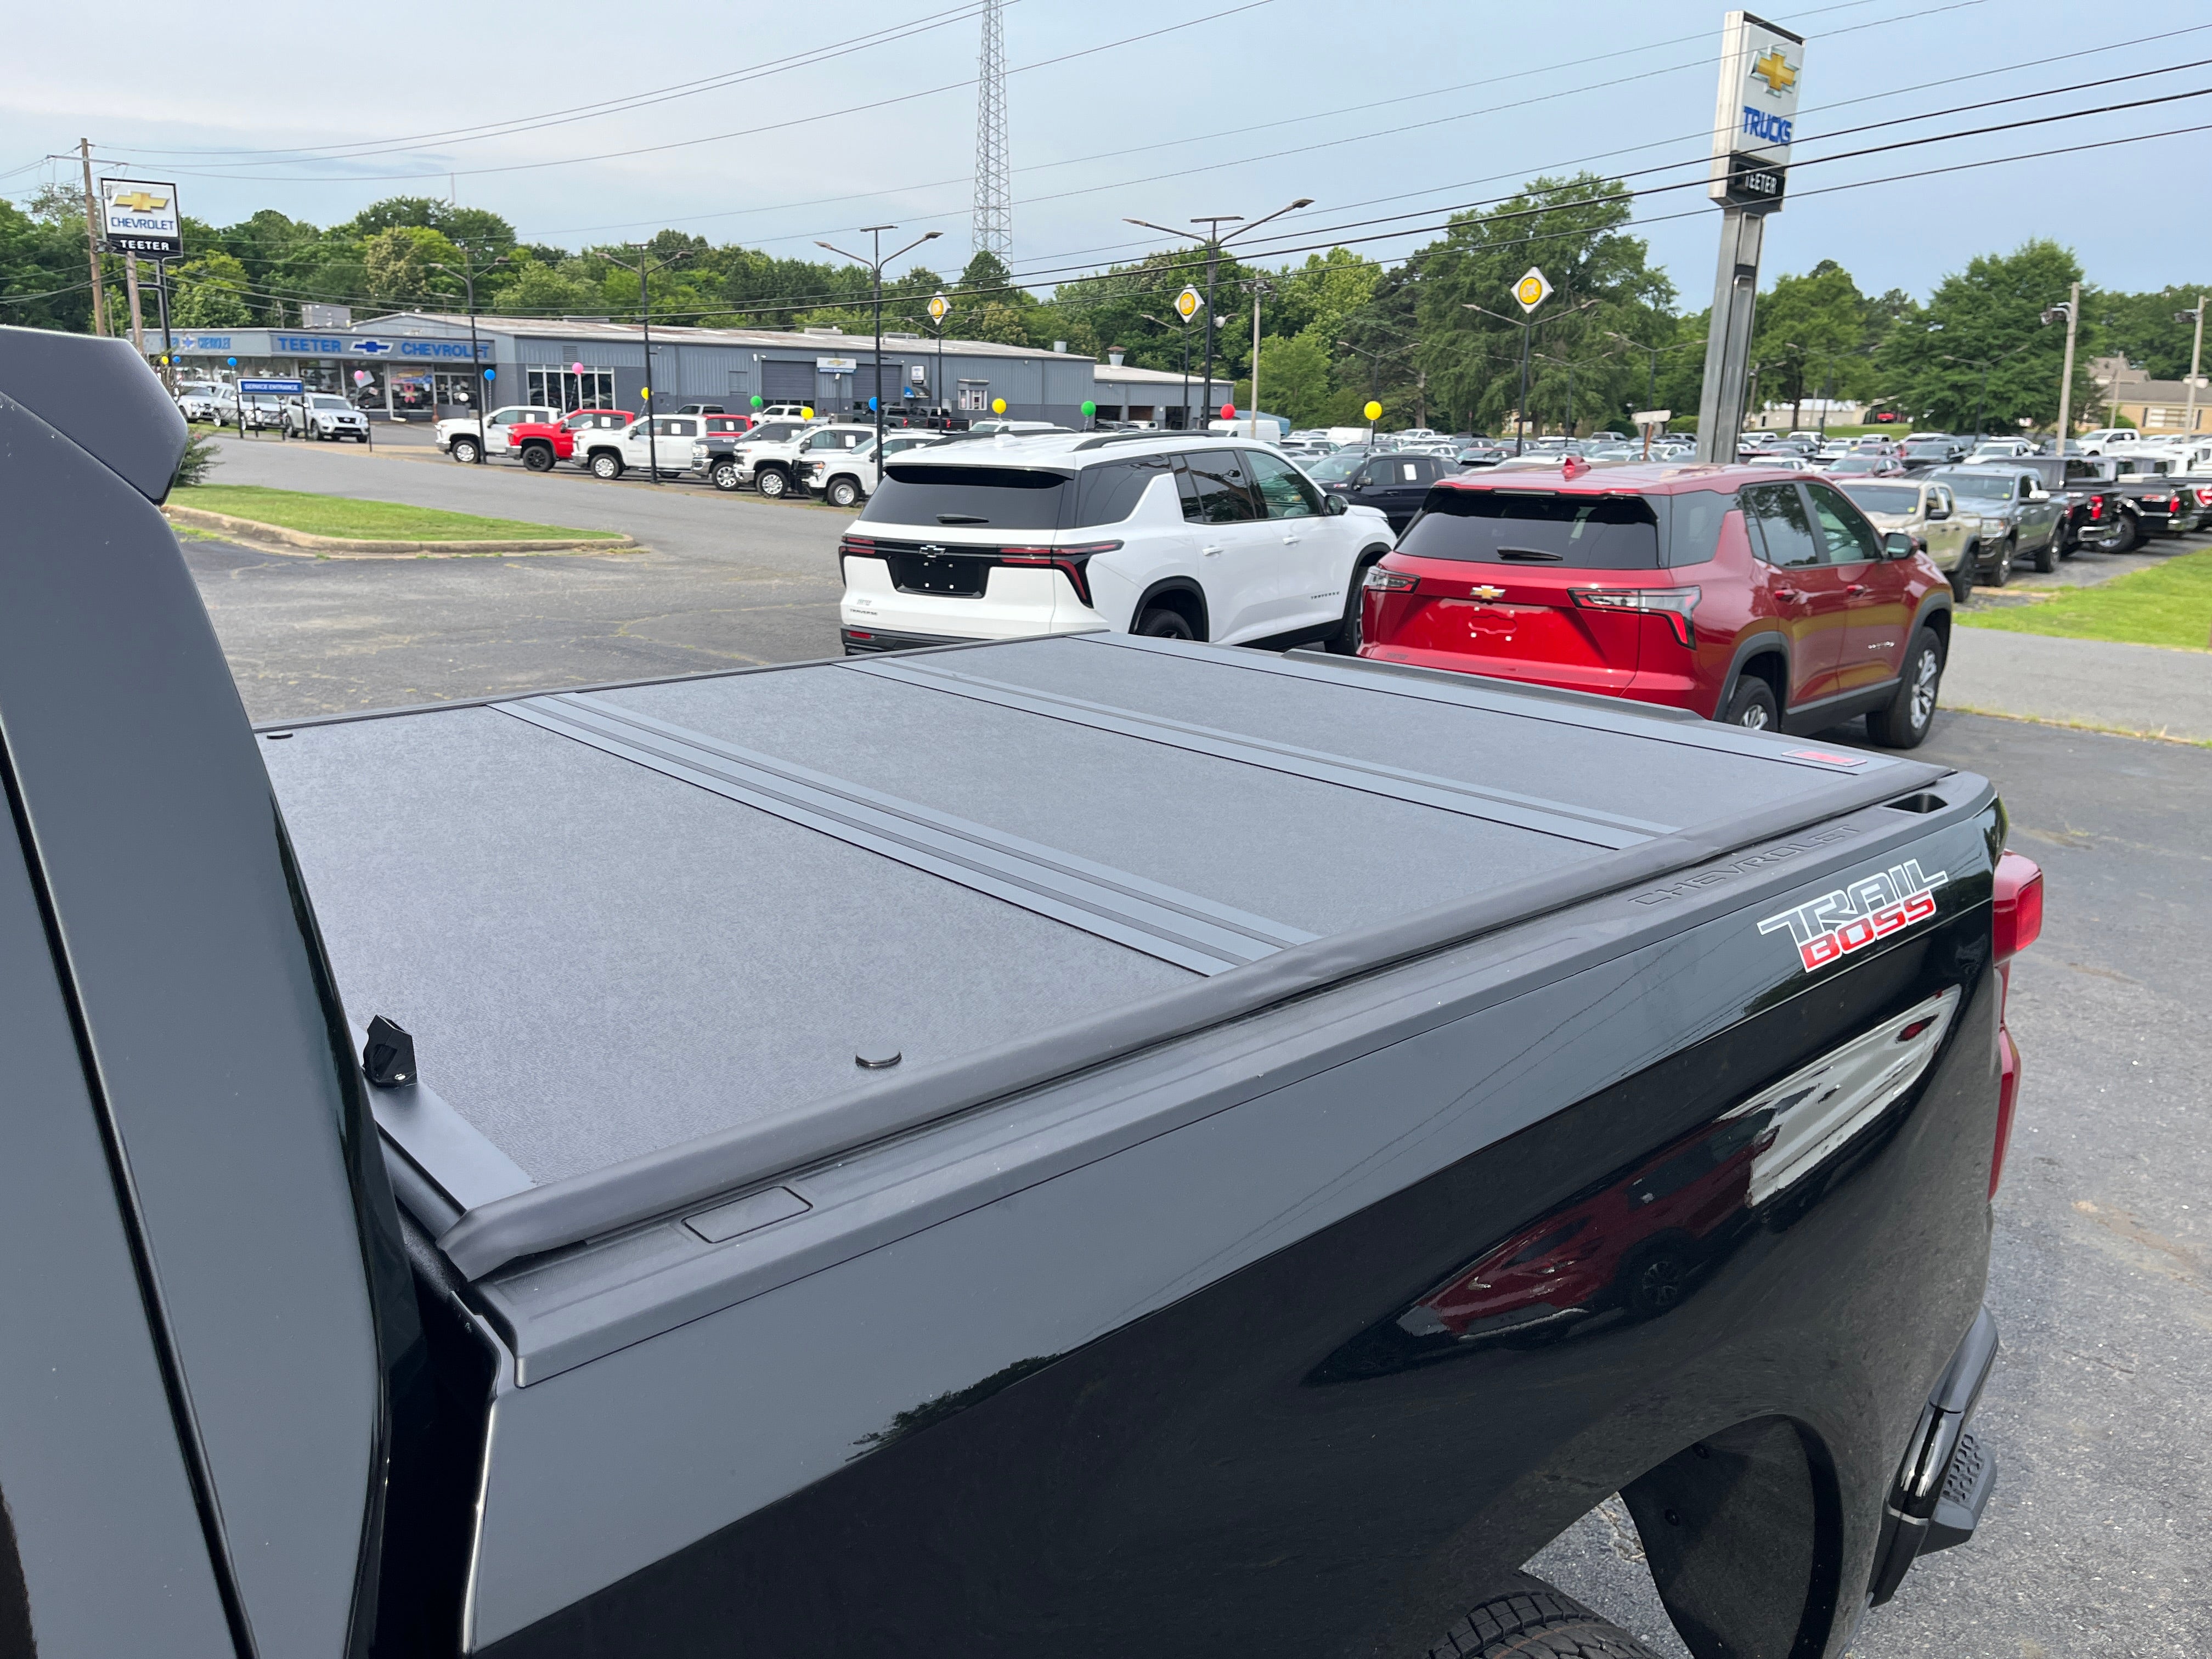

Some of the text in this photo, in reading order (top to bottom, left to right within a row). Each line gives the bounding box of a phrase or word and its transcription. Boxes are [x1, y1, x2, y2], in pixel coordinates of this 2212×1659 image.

[1743, 105, 1792, 146] TRUCKS
[1745, 170, 1778, 194] TEETER
[111, 217, 174, 230] CHEVROLET
[120, 240, 170, 251] TEETER
[278, 337, 341, 352] TEETER
[1627, 824, 1860, 905] CHEVROLET
[1757, 859, 1949, 945] TRAIL
[1799, 889, 1937, 973] BOSS
